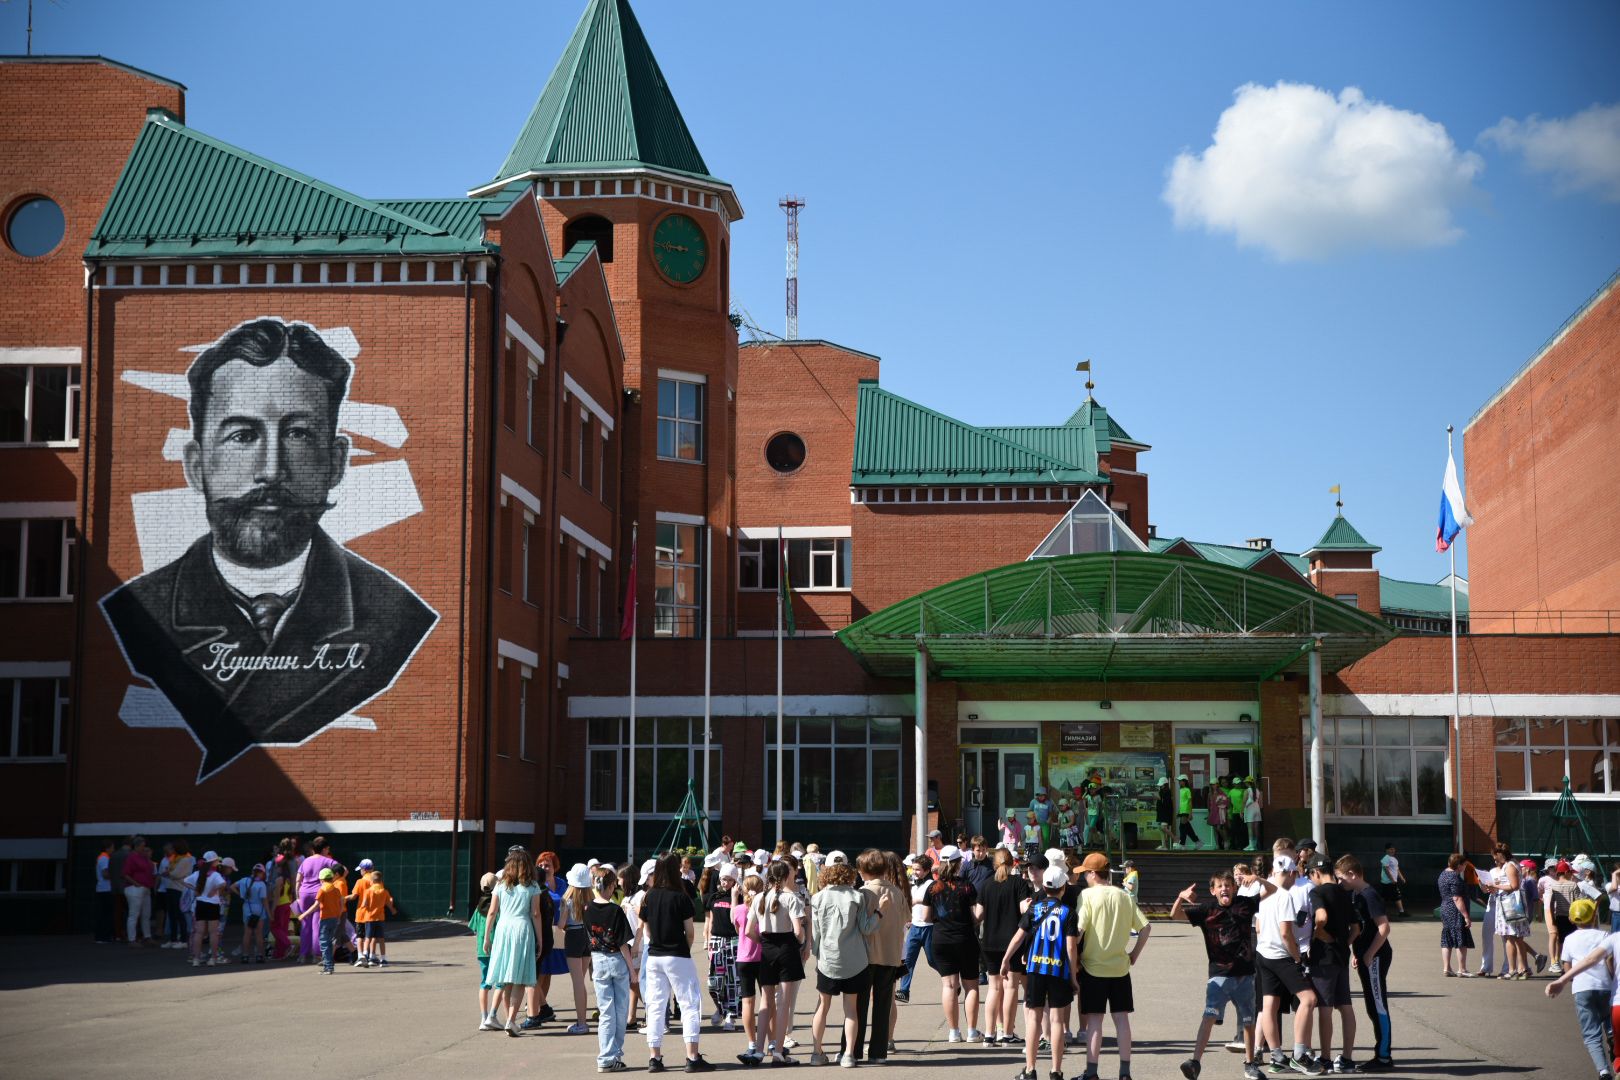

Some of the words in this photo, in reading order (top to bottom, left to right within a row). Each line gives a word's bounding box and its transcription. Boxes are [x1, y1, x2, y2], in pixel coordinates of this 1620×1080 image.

[202, 641, 300, 682] Пушкин
[1041, 916, 1060, 941] 10
[1032, 956, 1063, 966] enovo
